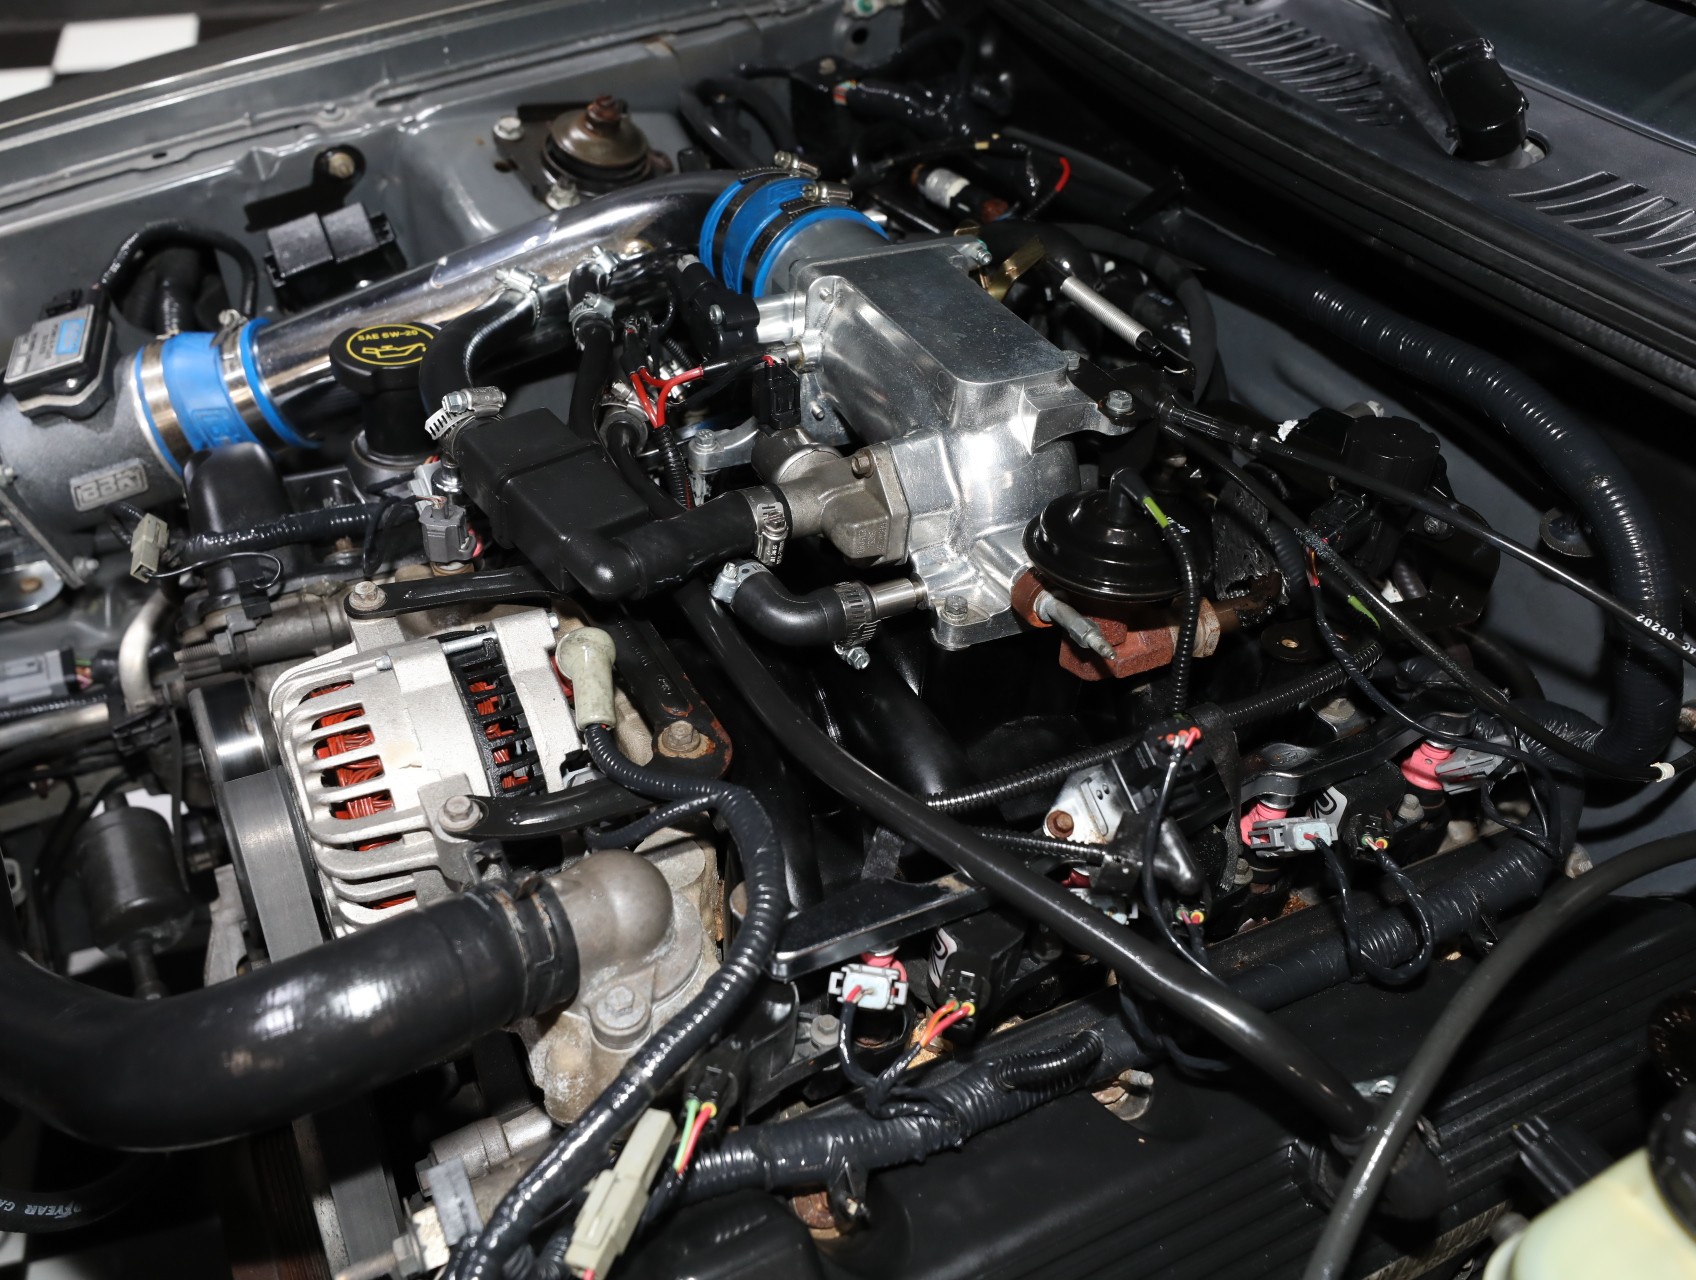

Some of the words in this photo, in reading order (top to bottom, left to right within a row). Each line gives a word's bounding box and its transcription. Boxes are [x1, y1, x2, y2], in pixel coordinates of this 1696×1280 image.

[357, 332, 379, 342] SAE
[78, 466, 139, 504] BBK
[1636, 613, 1676, 641] 05202
